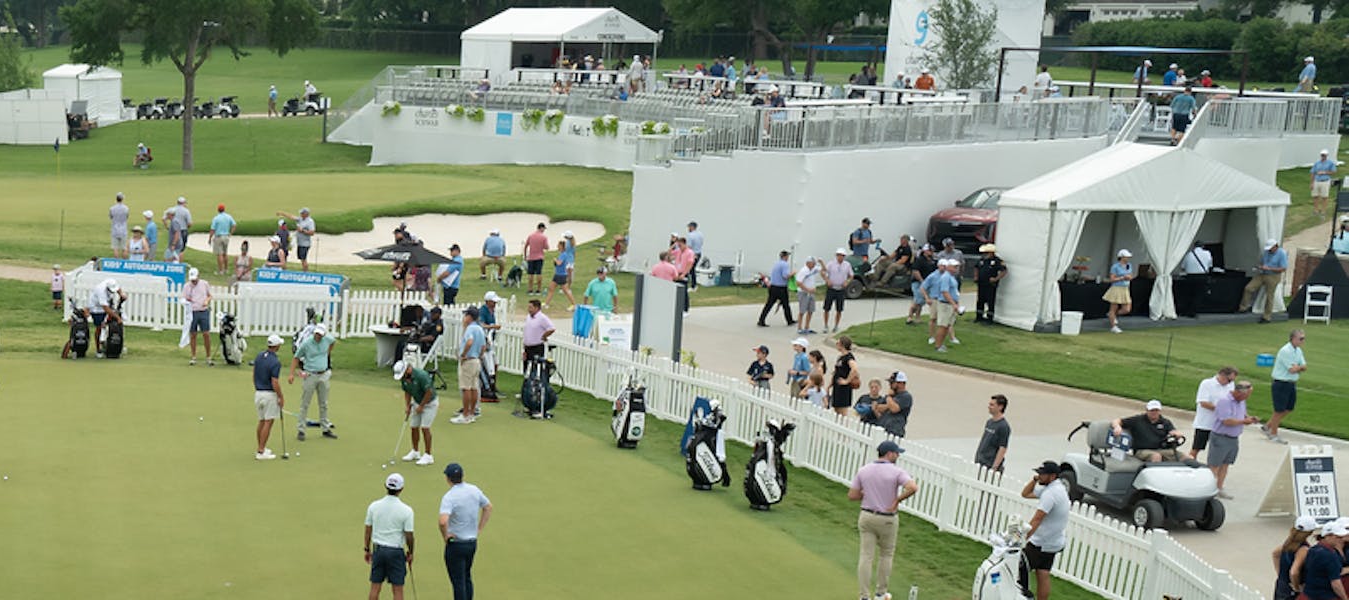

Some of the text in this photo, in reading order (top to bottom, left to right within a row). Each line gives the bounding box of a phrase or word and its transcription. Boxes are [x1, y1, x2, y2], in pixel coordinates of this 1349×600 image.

[914, 10, 929, 46] 9
[123, 262, 164, 272] AUTOGRAPH
[166, 265, 184, 273] ZONE
[279, 273, 321, 283] AUTOGRAPH
[323, 276, 341, 284] ZONE
[1309, 475, 1320, 483] NO
[1303, 485, 1329, 494] CARTS
[1305, 496, 1330, 505] AFTER
[1308, 507, 1330, 516] 11:00
